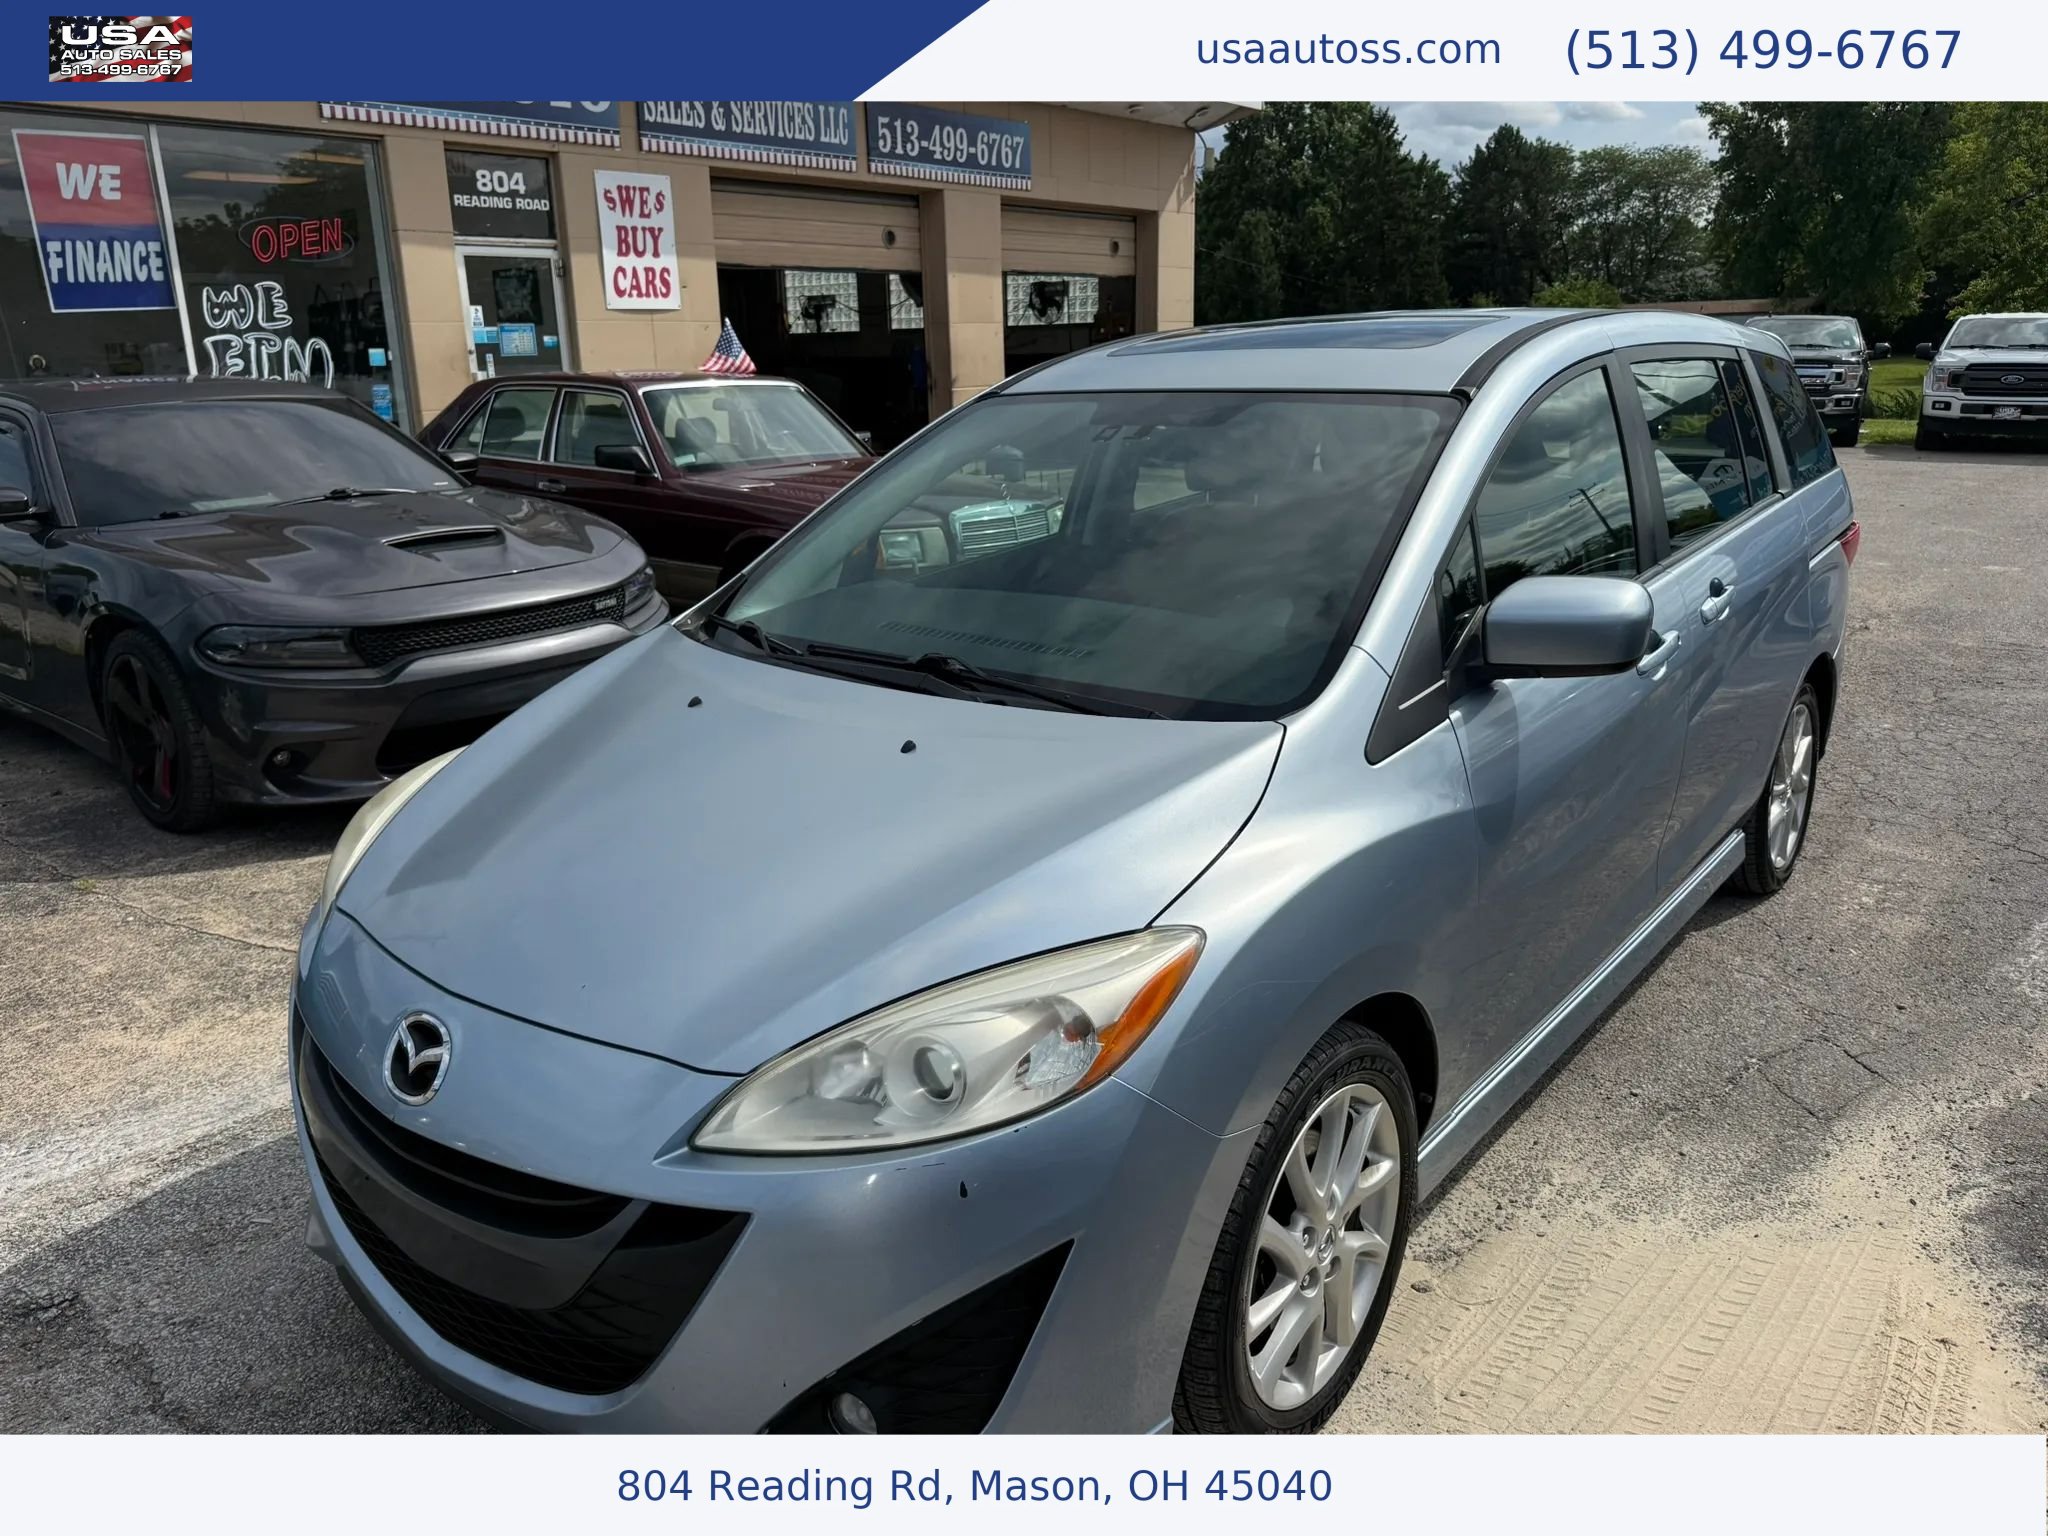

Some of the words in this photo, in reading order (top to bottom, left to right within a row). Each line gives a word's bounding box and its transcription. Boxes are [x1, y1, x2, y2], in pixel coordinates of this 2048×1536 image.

[643, 101, 706, 129] SALES
[710, 101, 727, 132] &
[731, 101, 815, 142] SERVICES
[819, 104, 849, 146] LLC
[877, 116, 1025, 170] 513-499-6767
[56, 162, 122, 200] WE
[476, 169, 527, 195] 804
[454, 193, 515, 210] READING
[516, 196, 550, 212] ROAD
[251, 218, 343, 263] OPEN
[615, 225, 664, 259] BUY
[46, 240, 165, 284] FINANCE
[613, 266, 672, 299] CARS
[203, 281, 293, 329] WE
